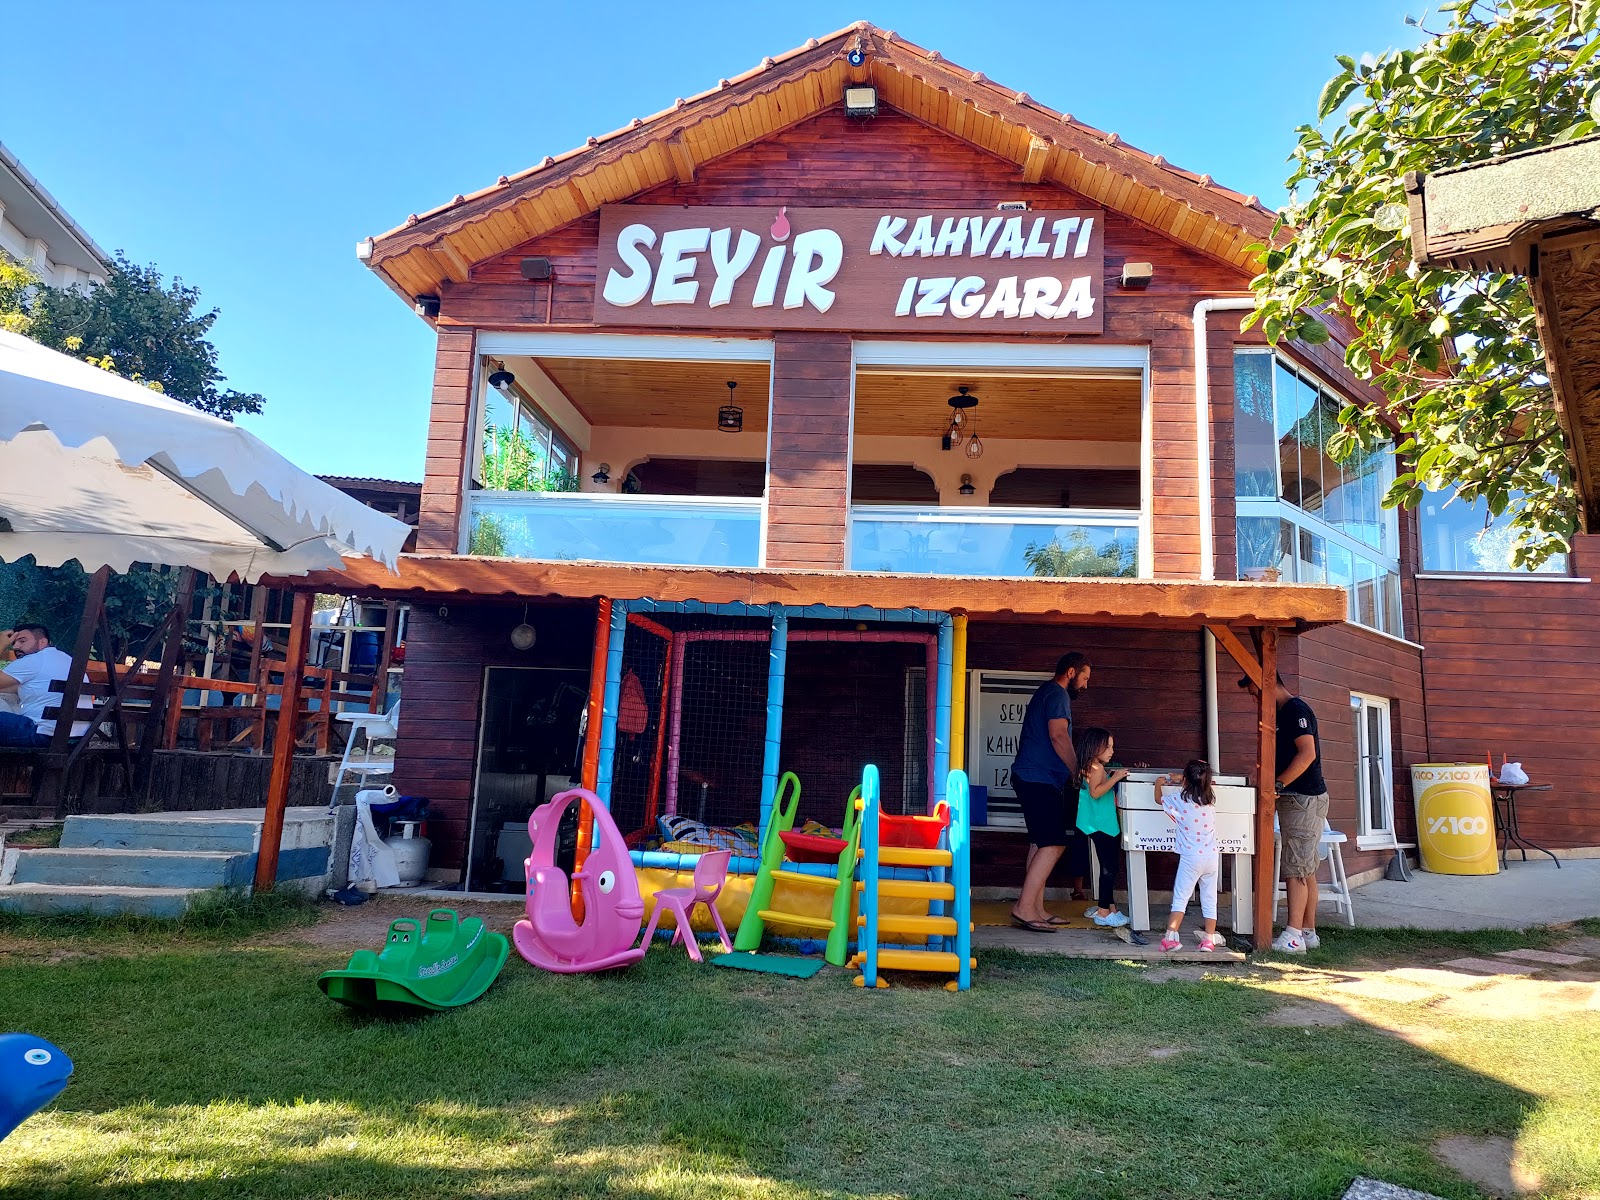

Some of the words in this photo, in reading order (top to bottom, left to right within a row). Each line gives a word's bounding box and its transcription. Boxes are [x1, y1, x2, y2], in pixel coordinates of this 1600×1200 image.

[602, 206, 844, 313] SEYİR
[869, 215, 1095, 260] KAHVALTI
[895, 275, 1097, 320] IZGARA
[1437, 771, 1470, 780] %100
[1427, 816, 1488, 836] %100
